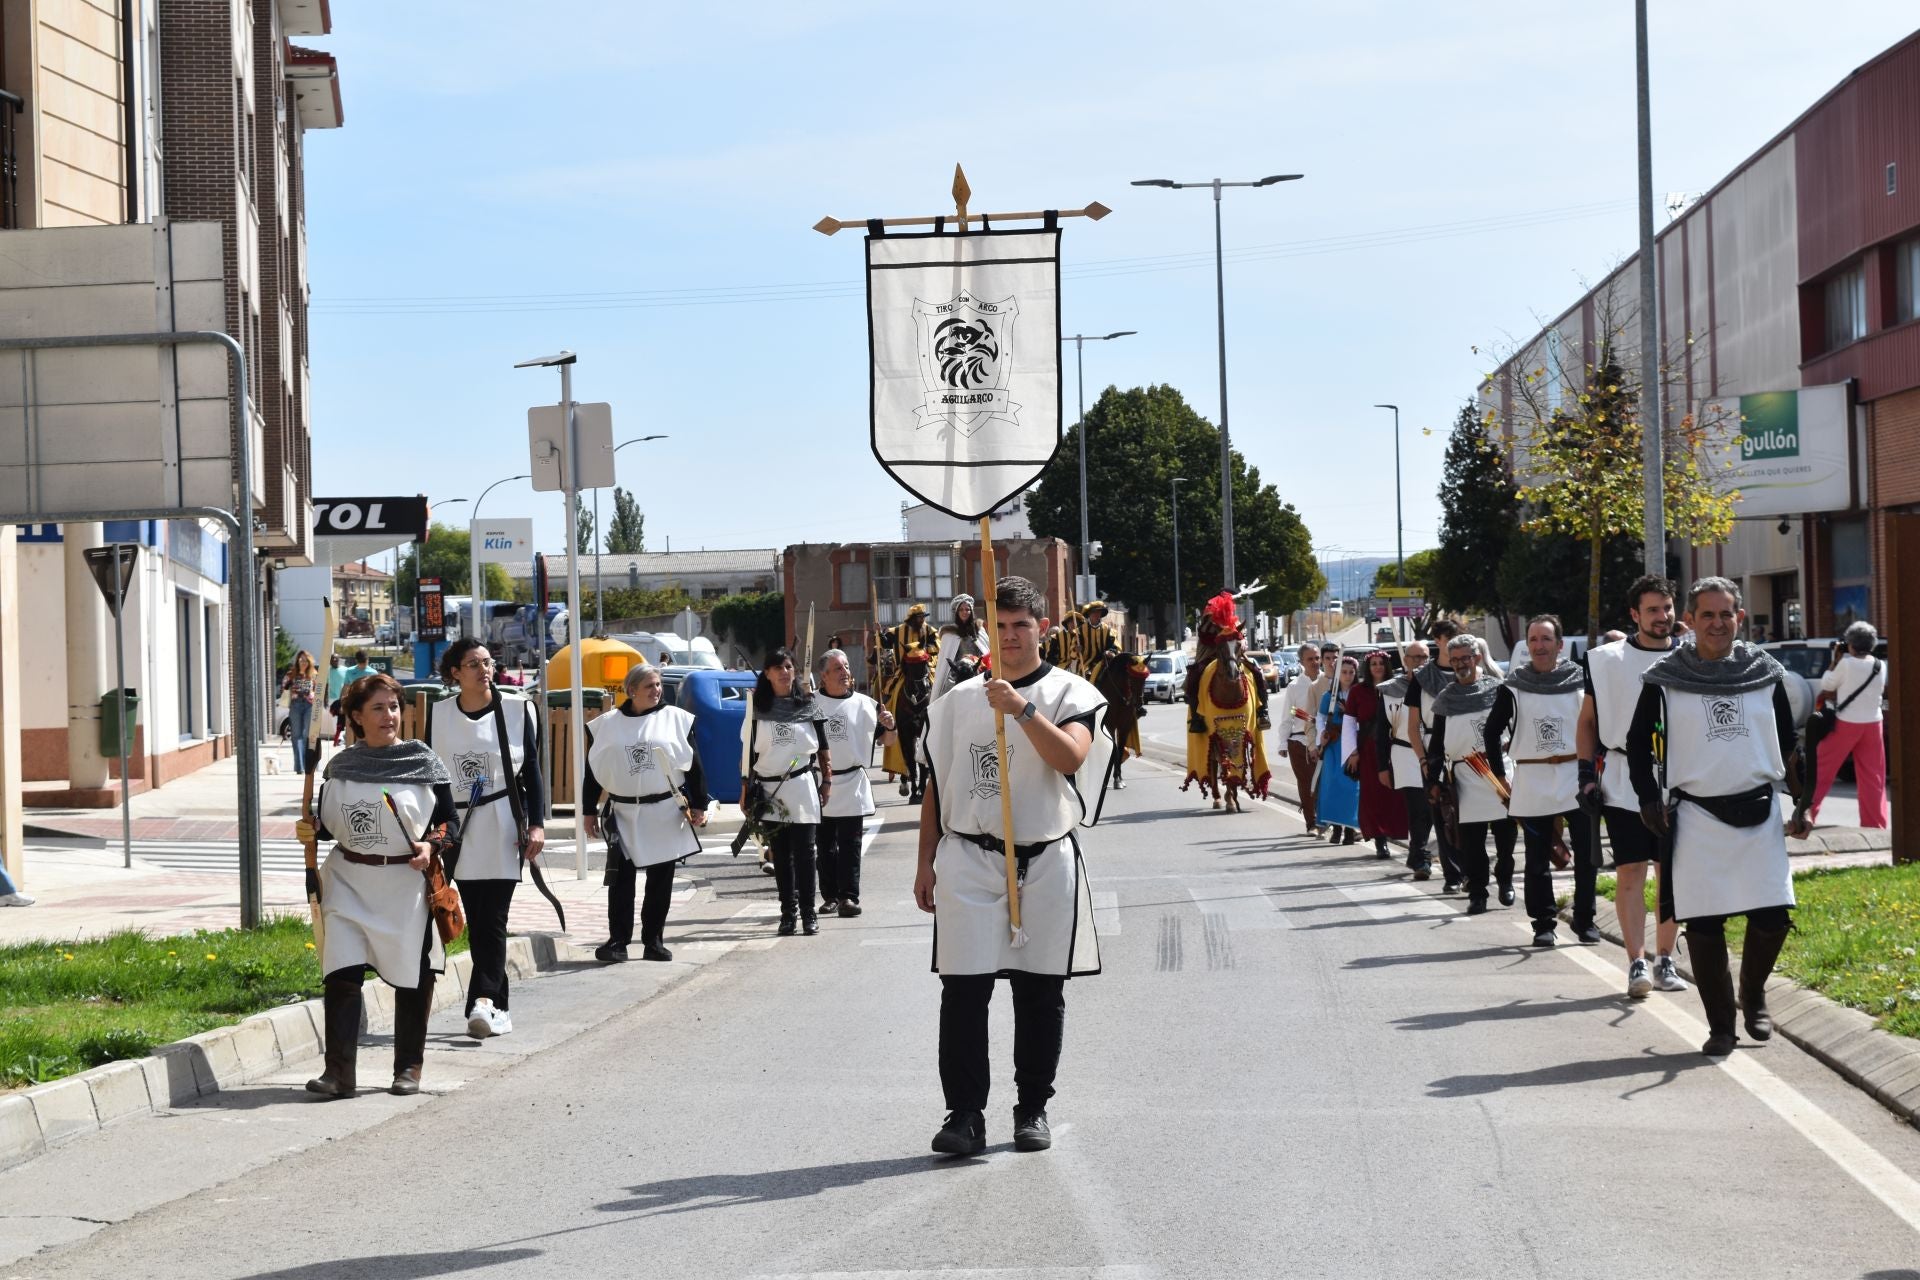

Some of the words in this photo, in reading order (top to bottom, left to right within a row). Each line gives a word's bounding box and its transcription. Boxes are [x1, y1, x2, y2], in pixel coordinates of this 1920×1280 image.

[936, 305, 953, 313] TIRO
[978, 303, 998, 312] ARCO
[941, 393, 993, 404] AGUILARCO
[1743, 428, 1797, 457] gullón
[484, 537, 513, 550] Klin
